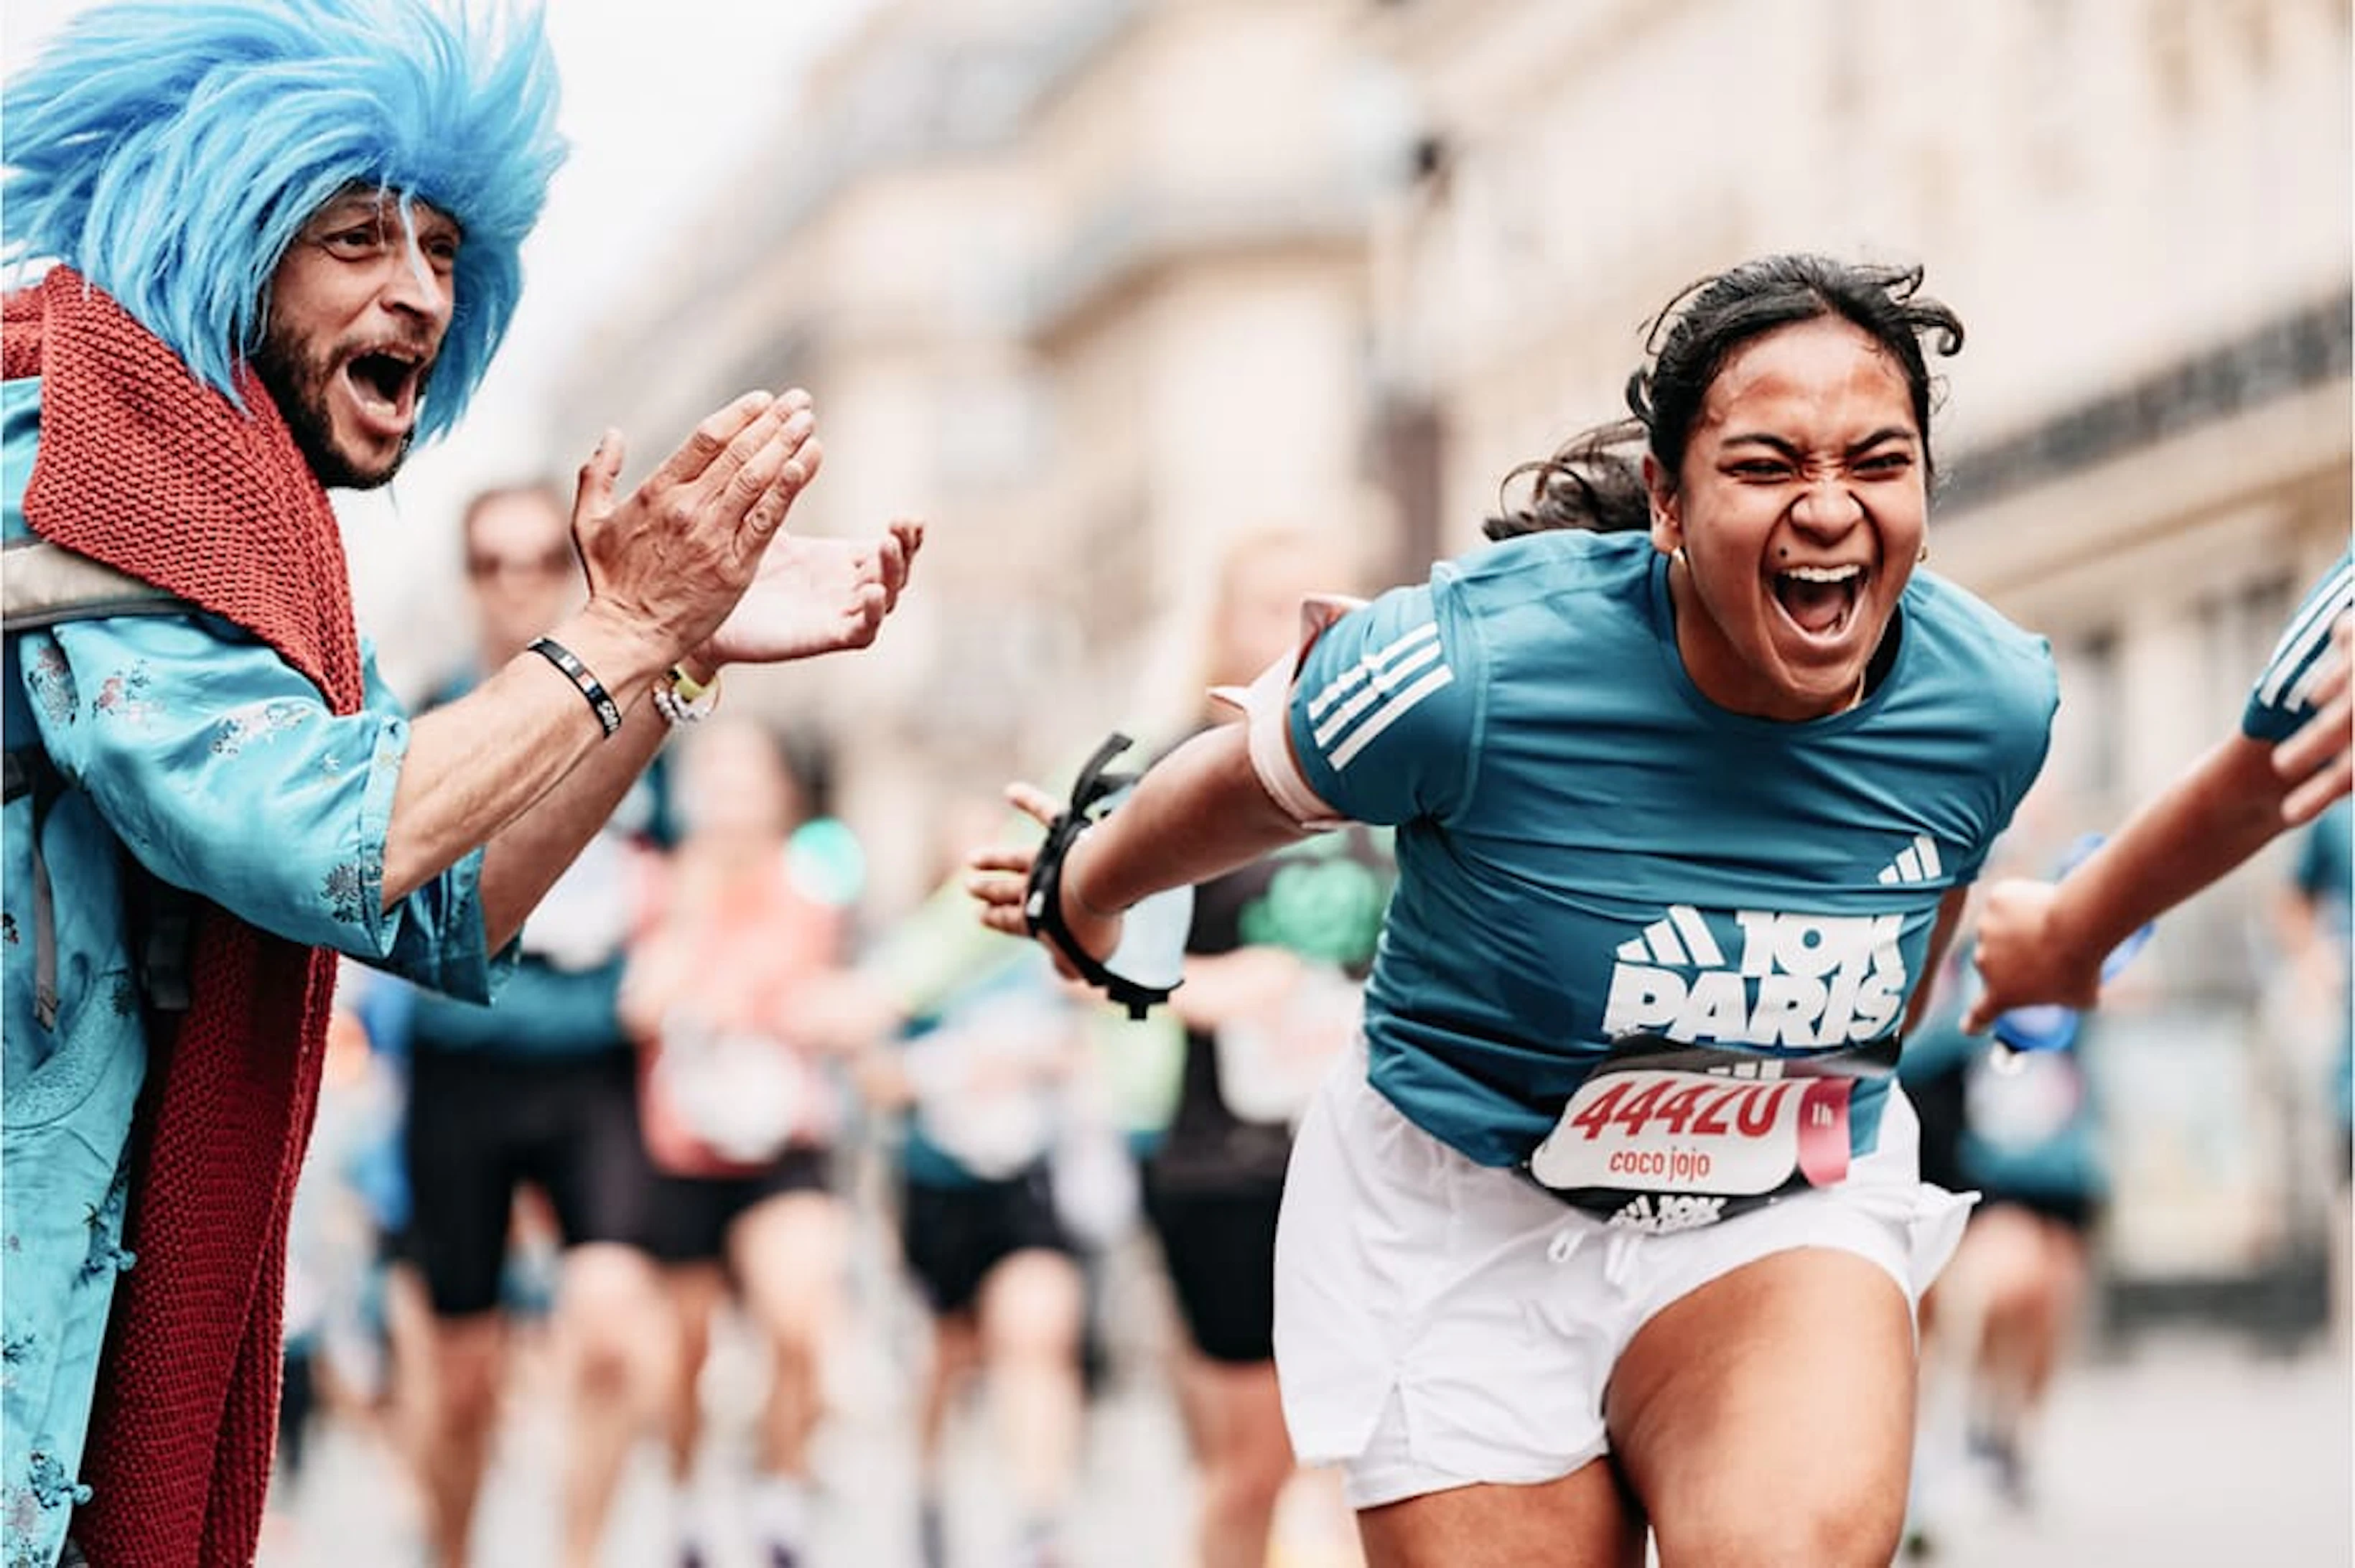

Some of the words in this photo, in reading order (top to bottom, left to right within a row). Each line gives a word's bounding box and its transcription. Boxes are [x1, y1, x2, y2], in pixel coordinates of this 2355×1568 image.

[1735, 910, 1904, 976] 10K
[1602, 962, 1906, 1047] PARIS
[1571, 1079, 1791, 1139] 44420
[1610, 1152, 1664, 1175] coco
[1669, 1147, 1710, 1182] jojo
